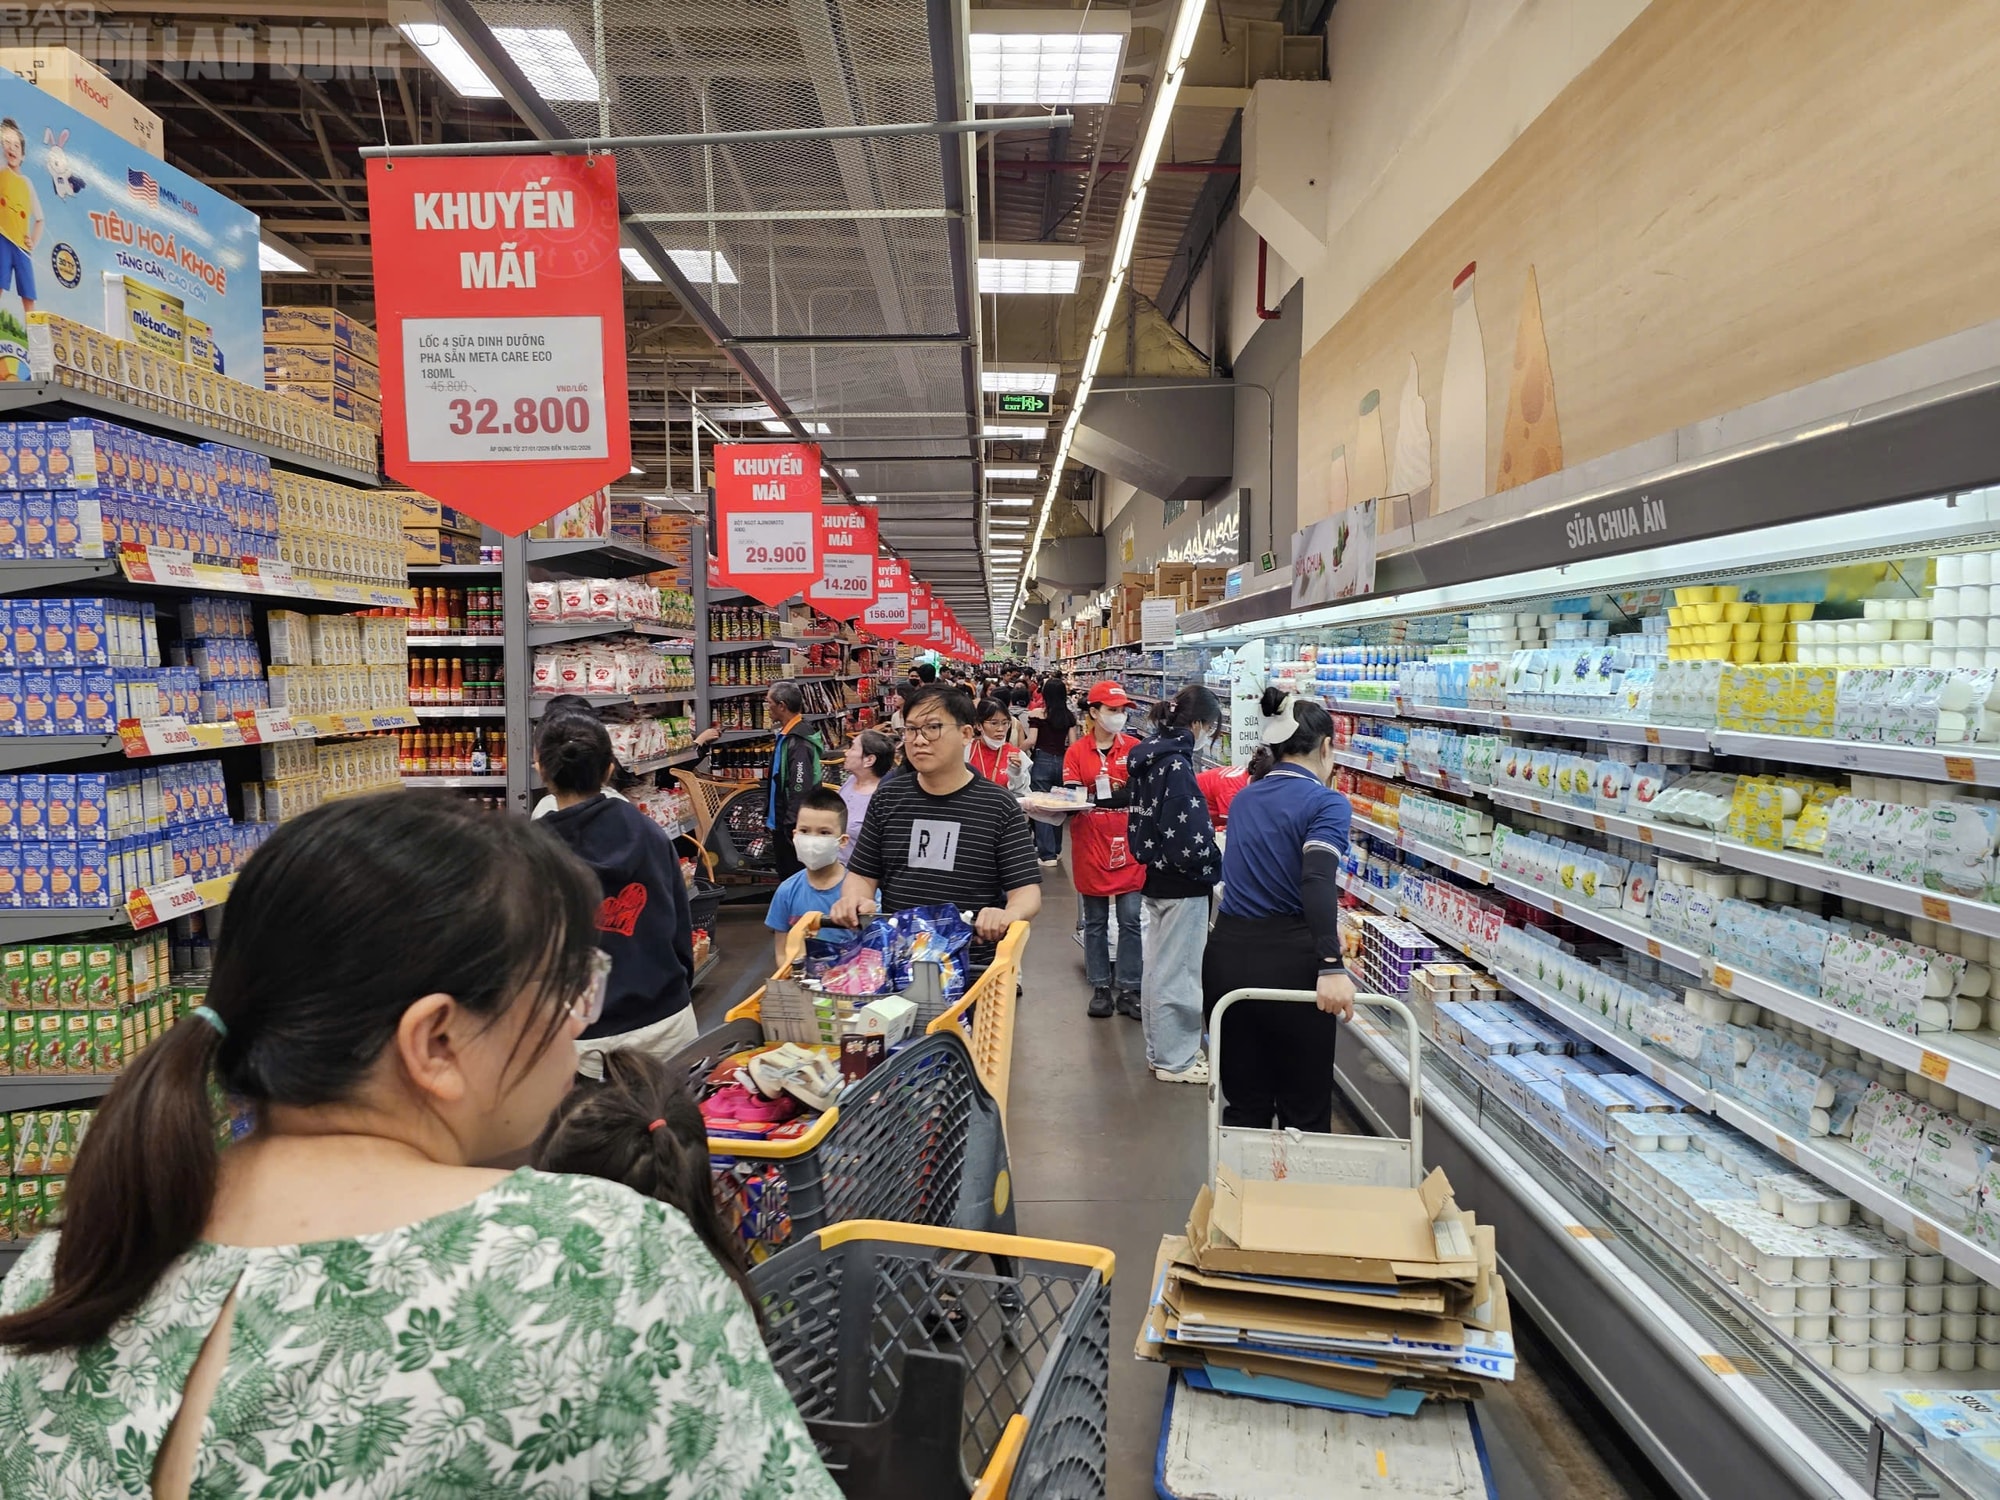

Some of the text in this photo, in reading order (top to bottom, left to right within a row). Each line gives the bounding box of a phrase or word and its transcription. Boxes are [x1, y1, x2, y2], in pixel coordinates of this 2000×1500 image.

[413, 176, 575, 231] KHUYẾN
[90, 209, 226, 294] TIÊU HOÁ KHOẺ
[116, 251, 143, 275] TĂNG
[168, 272, 188, 290] CAO
[459, 241, 537, 289] MÃI
[419, 333, 545, 348] LỐC 4 SỮA DINH DƯỠNG
[420, 353, 442, 363] PHA
[469, 352, 499, 363] META
[501, 351, 530, 362] CARE
[532, 351, 553, 362] ECO
[421, 368, 456, 379] 180ML
[449, 396, 590, 435] 32.800
[733, 452, 803, 476] KHUYẾN
[752, 479, 786, 501] MÃI
[1566, 495, 1667, 549] SỮA CHUA ĂN
[828, 531, 853, 546] MÃI
[746, 546, 806, 563] 29.900
[878, 564, 902, 576] UYẾN
[824, 578, 867, 591] 14.200
[869, 610, 905, 619] 156.000
[162, 731, 190, 744] 32.800
[1239, 731, 1259, 740] CHUA
[795, 761, 804, 783] gojek
[917, 829, 951, 860] R I
[170, 890, 196, 907] 32.800
